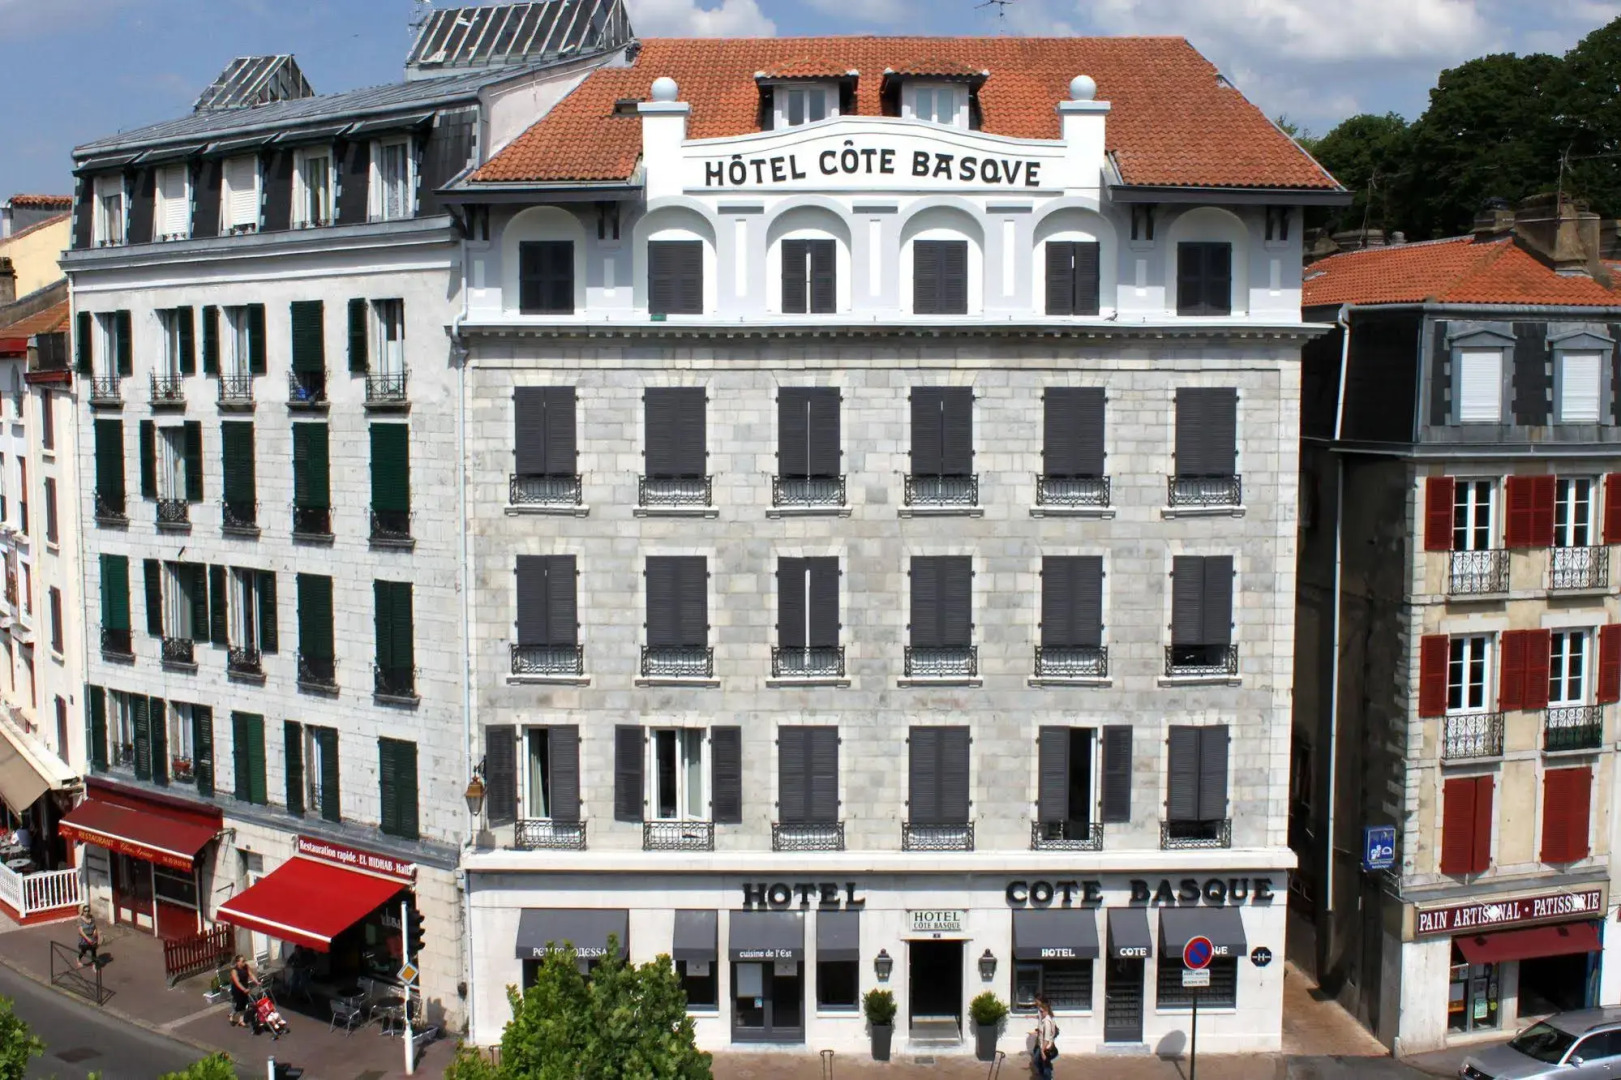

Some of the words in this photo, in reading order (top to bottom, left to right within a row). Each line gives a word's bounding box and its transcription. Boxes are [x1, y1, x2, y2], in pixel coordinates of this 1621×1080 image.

[705, 154, 806, 186] HÔTEL
[819, 140, 896, 175] CÔTE
[299, 839, 336, 858] Restauration
[337, 850, 357, 863] rapide
[742, 882, 865, 906] HOTEL
[1005, 880, 1104, 903] COTE
[1129, 878, 1274, 903] BASQUE
[914, 911, 960, 922] HOTEL
[1419, 911, 1448, 931] PAIN
[1453, 902, 1520, 927] ARTISNAL
[739, 949, 765, 958] cuisine
[765, 949, 774, 958] de
[1041, 948, 1075, 957] HOTEL
[1119, 947, 1147, 956] COTE
